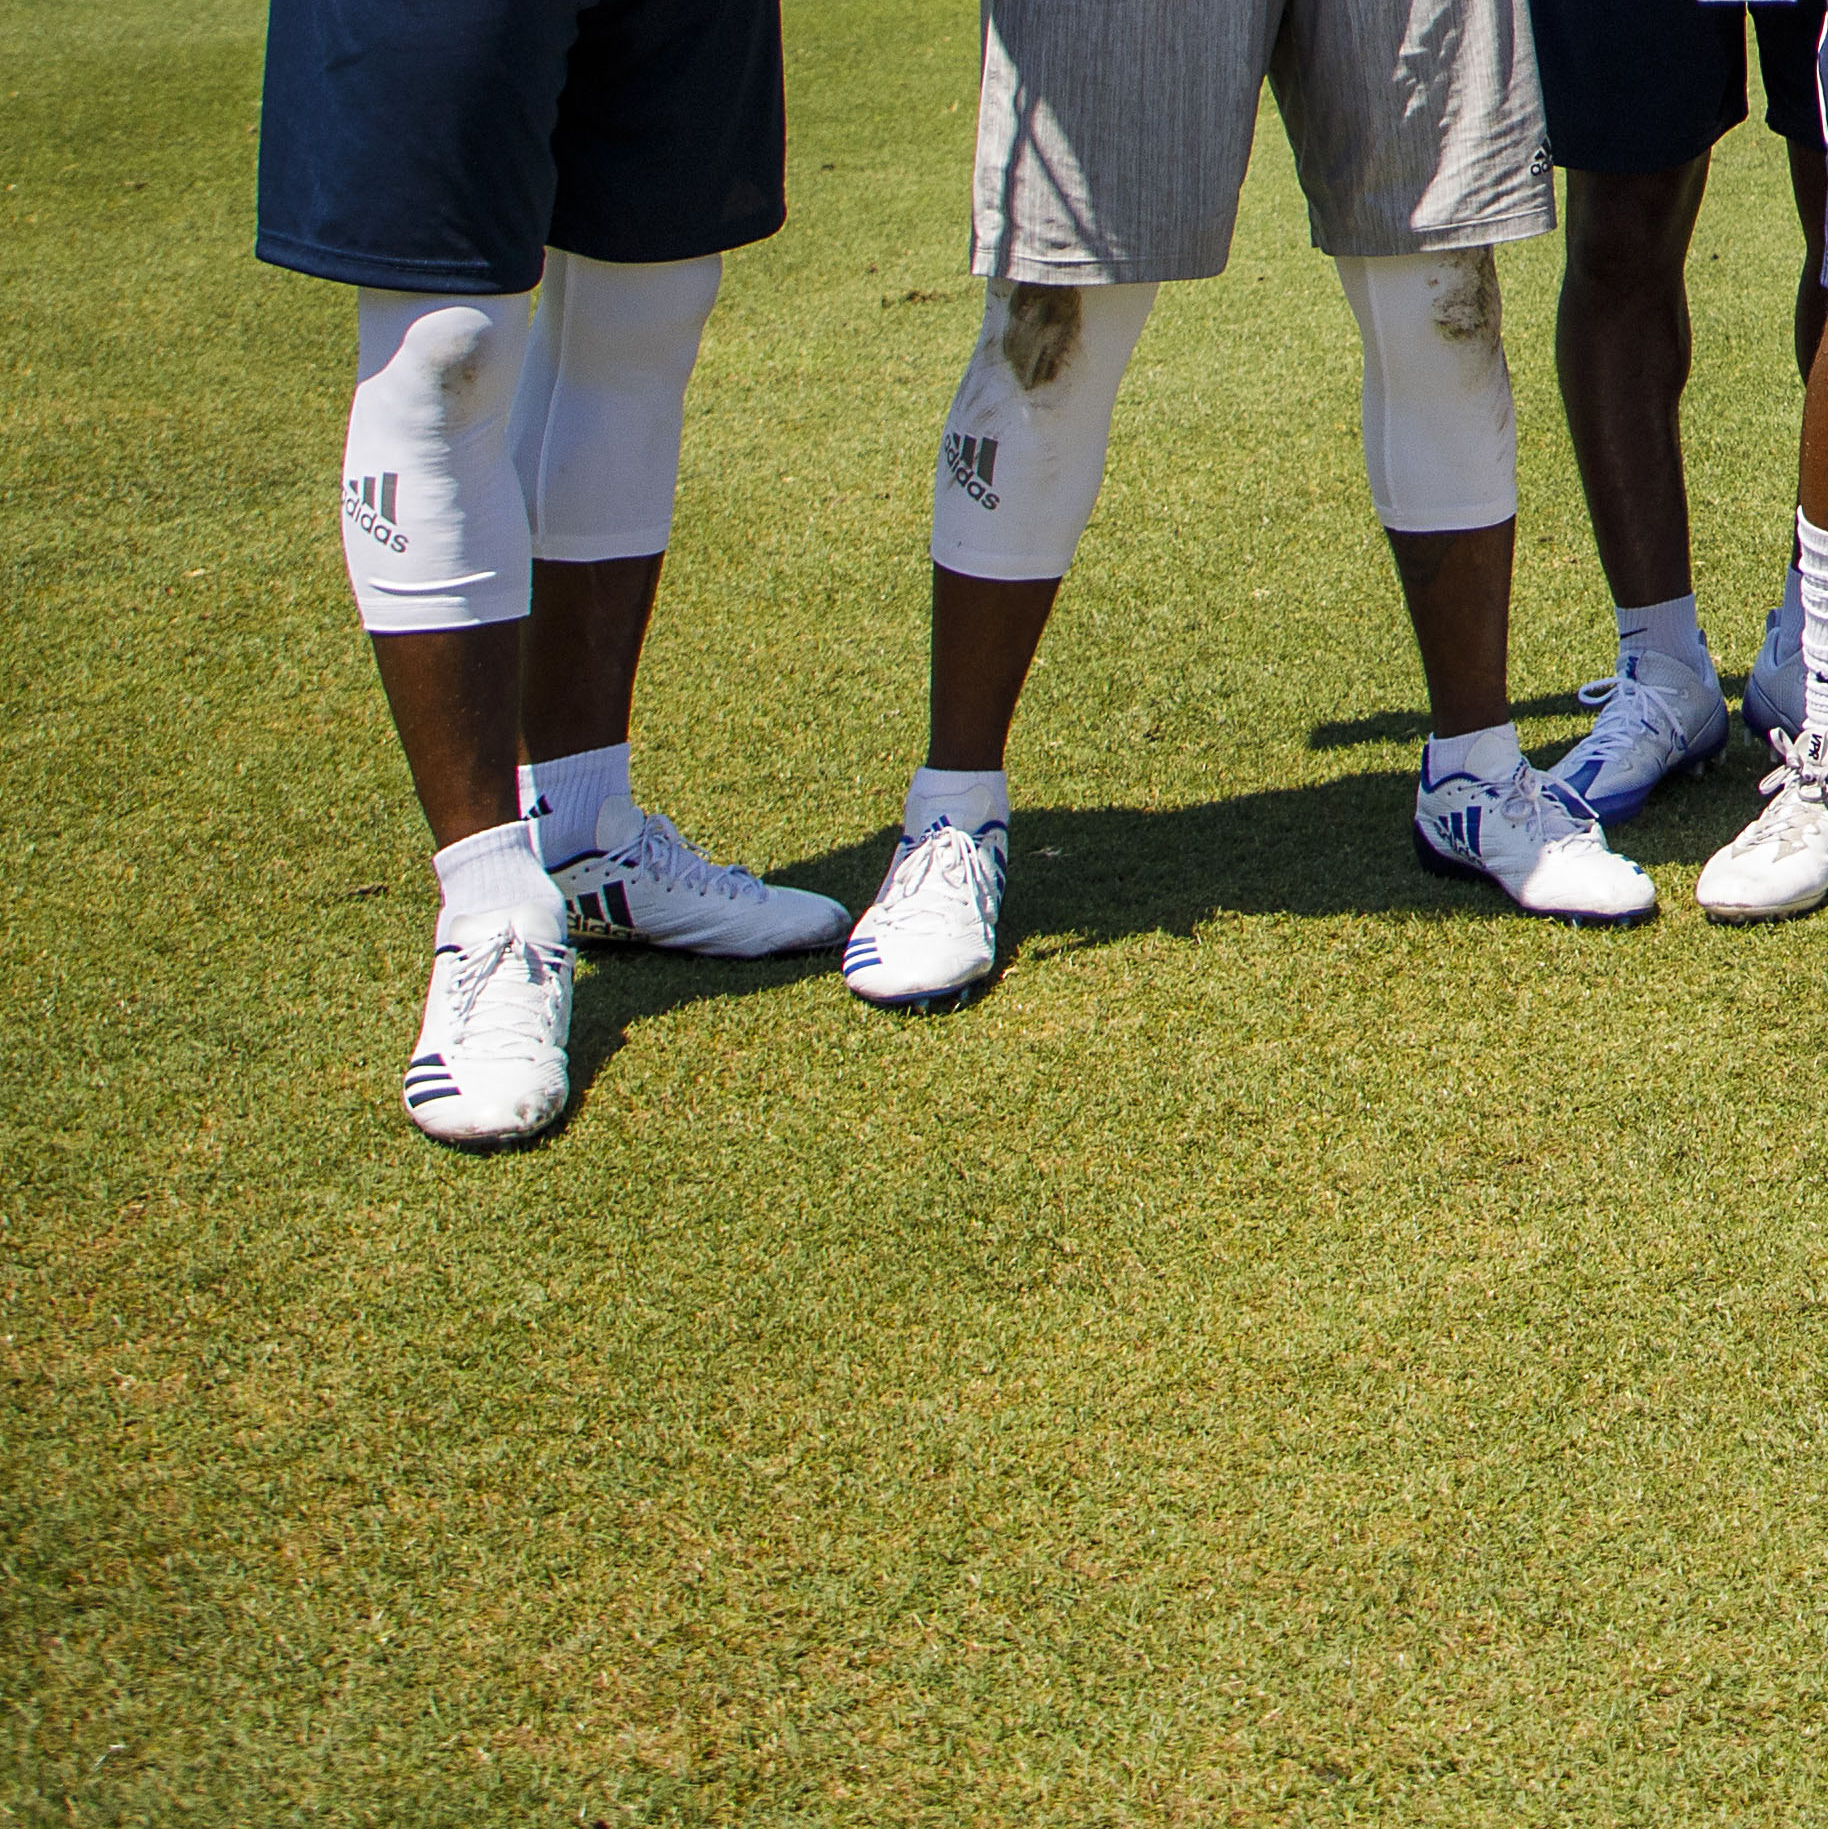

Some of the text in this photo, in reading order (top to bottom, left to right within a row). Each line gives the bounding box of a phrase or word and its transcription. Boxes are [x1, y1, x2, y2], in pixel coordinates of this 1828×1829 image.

[944, 433, 1001, 511] adidas
[343, 494, 410, 554] didas
[1808, 732, 1823, 761] VPR
